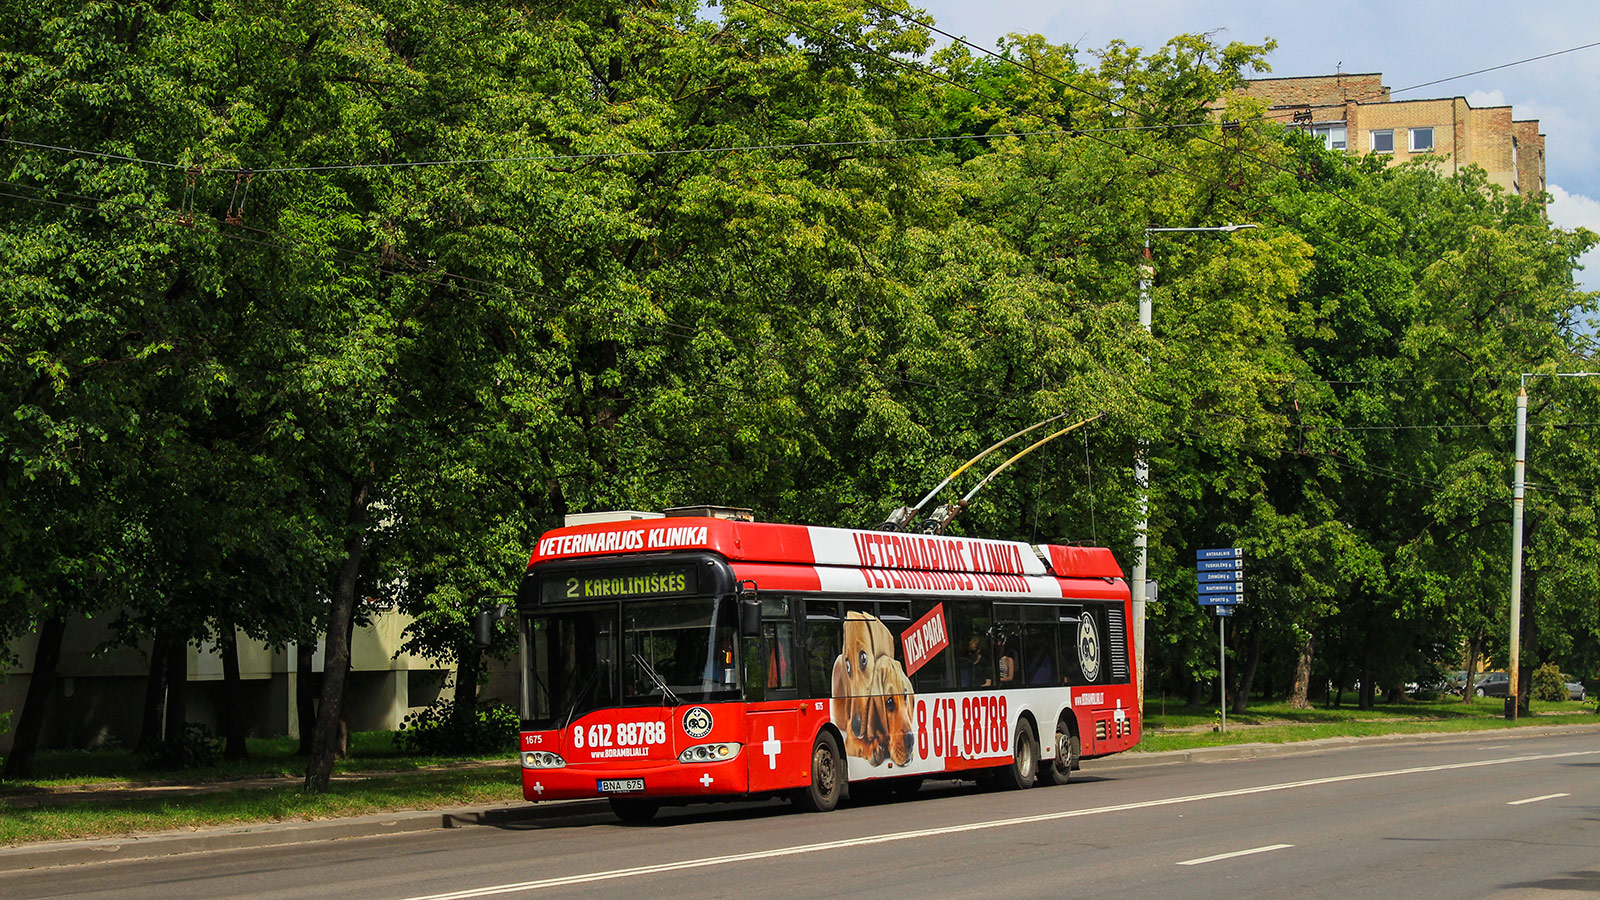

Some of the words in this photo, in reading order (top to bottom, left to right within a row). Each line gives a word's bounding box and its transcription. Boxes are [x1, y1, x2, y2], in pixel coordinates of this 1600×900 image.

[539, 529, 645, 556] VETERINARIJOS
[647, 526, 708, 549] KLINIKA
[853, 532, 973, 591] VETERINARIJOS
[968, 542, 1032, 593] KLINIKA
[566, 577, 580, 598] 2
[904, 628, 927, 666] VISĄ
[922, 613, 947, 652] PARĄ
[525, 734, 543, 745] 1675
[573, 725, 584, 749] 8
[588, 723, 613, 748] 612
[616, 721, 667, 746] 88788
[916, 700, 929, 760] 8
[932, 697, 957, 758] 612
[962, 695, 1009, 755] 88788
[603, 781, 621, 791] BNA
[626, 780, 642, 789] 675
